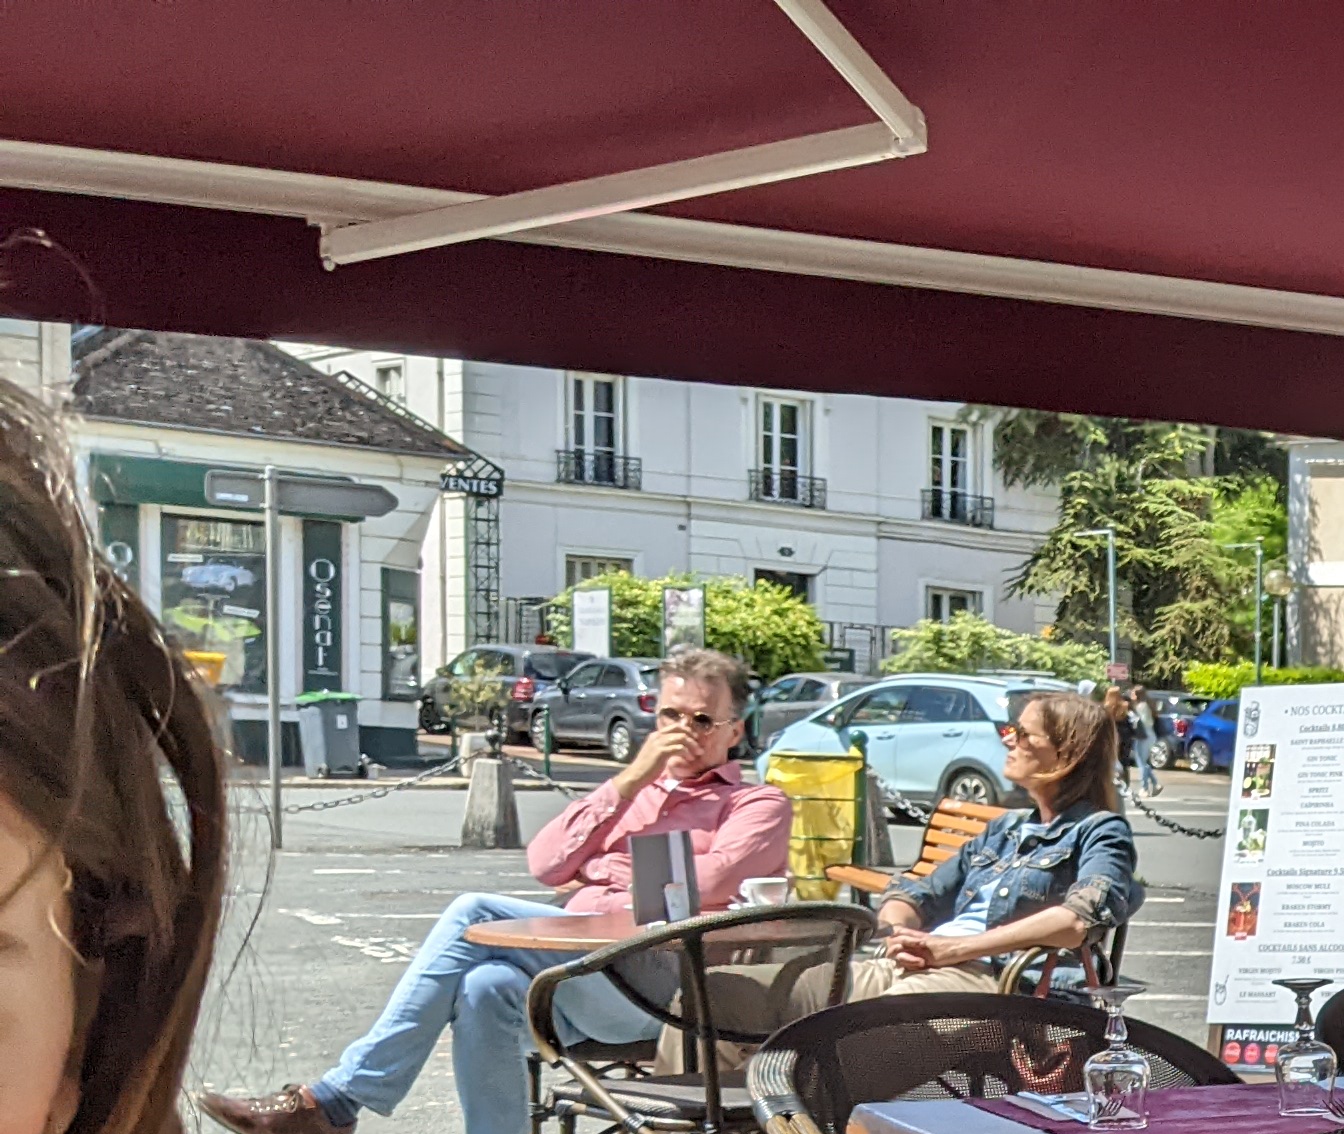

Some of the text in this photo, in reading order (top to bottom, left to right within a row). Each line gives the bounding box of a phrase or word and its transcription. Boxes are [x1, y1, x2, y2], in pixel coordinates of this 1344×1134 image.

[440, 476, 498, 495] VENTES
[1290, 705, 1310, 717] NOS
[1299, 724, 1330, 733] Cocktails
[1266, 868, 1298, 877] Cocktails
[1299, 868, 1332, 877] Signature
[1258, 943, 1298, 953] COCKTAILS
[1299, 943, 1318, 953] SANS
